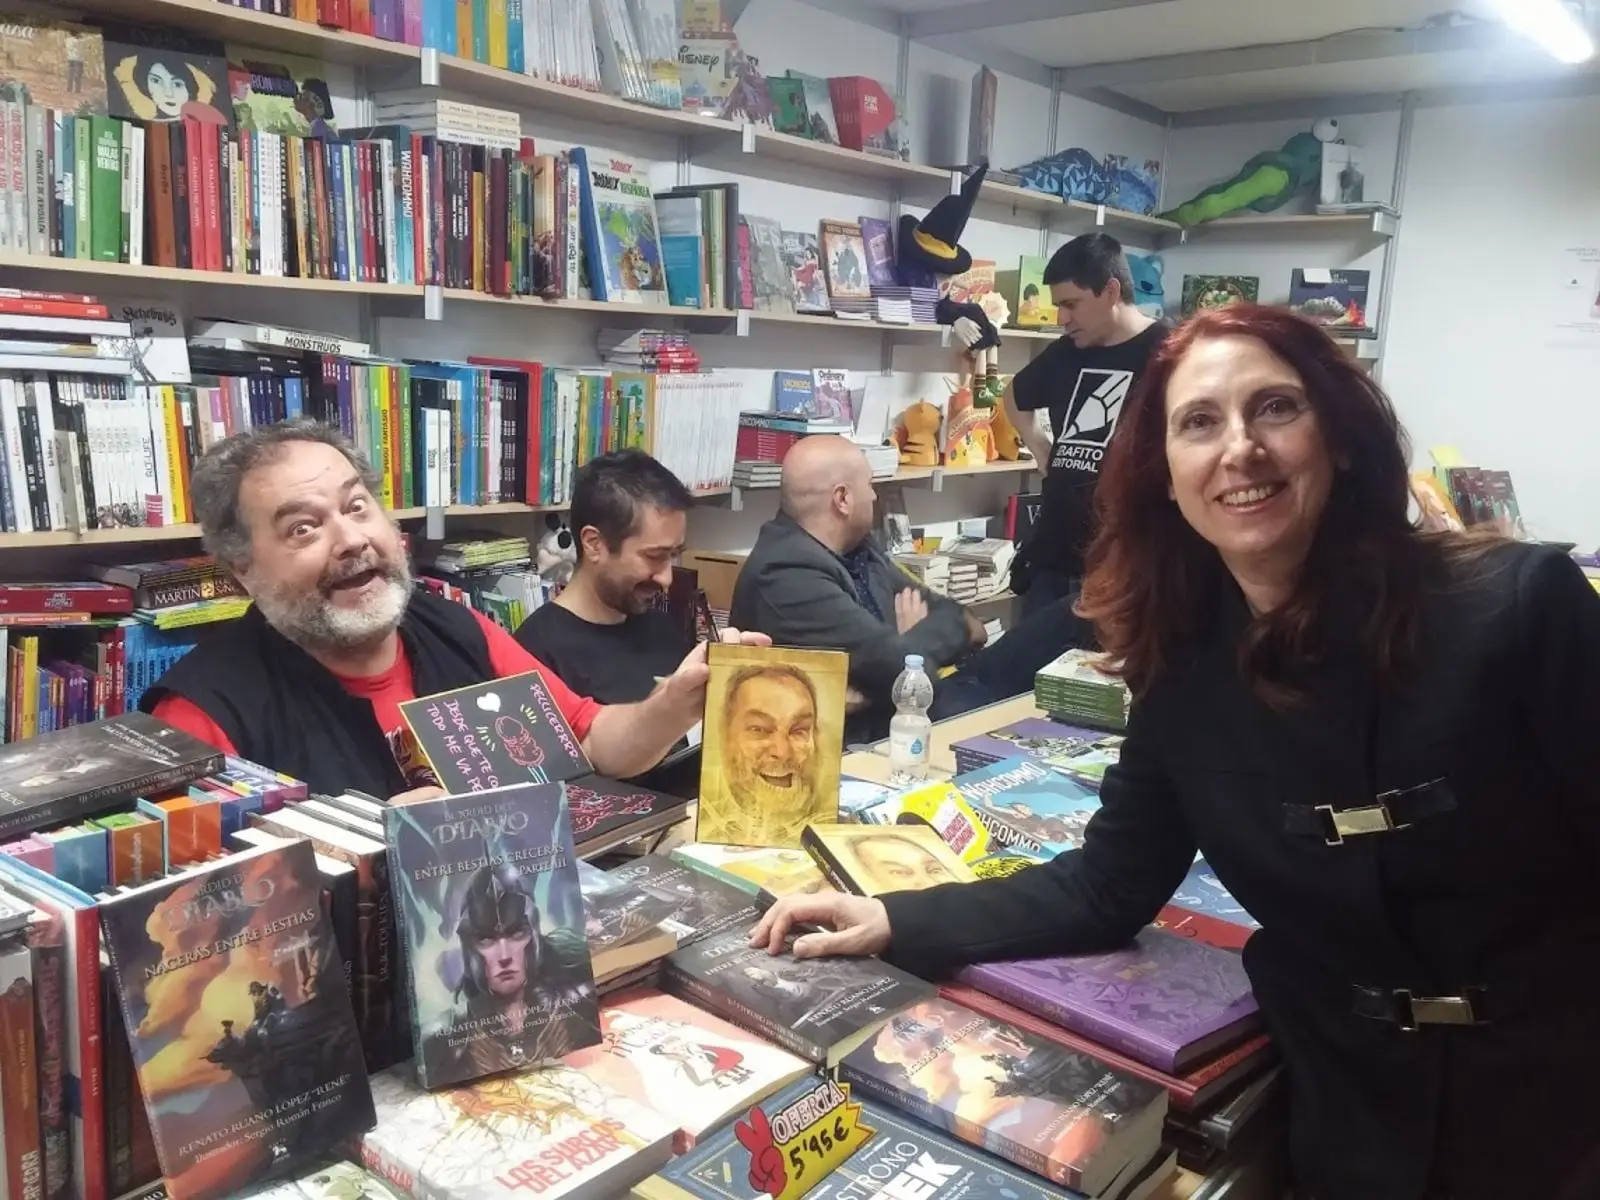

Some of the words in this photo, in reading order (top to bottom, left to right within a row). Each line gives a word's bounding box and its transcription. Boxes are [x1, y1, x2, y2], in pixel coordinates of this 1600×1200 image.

[285, 336, 342, 354] MONSTRUOS
[154, 587, 201, 607] MARTIN
[426, 703, 446, 731] TODO
[443, 735, 460, 755] ME
[456, 758, 472, 776] VA
[443, 699, 468, 733] DESDE
[463, 733, 482, 759] QUE
[478, 757, 492, 773] TE
[414, 861, 454, 881] ENTRE
[214, 928, 260, 955] ENTRE
[263, 908, 316, 935] BESTIAS
[179, 1127, 229, 1158] RENATO
[231, 1105, 274, 1134] RUANO
[771, 1079, 846, 1144] OFERTA
[494, 1158, 542, 1190] LOS
[540, 1115, 627, 1168] SURCOS
[519, 1165, 572, 1195] DEL
[564, 1137, 627, 1170] AZAR
